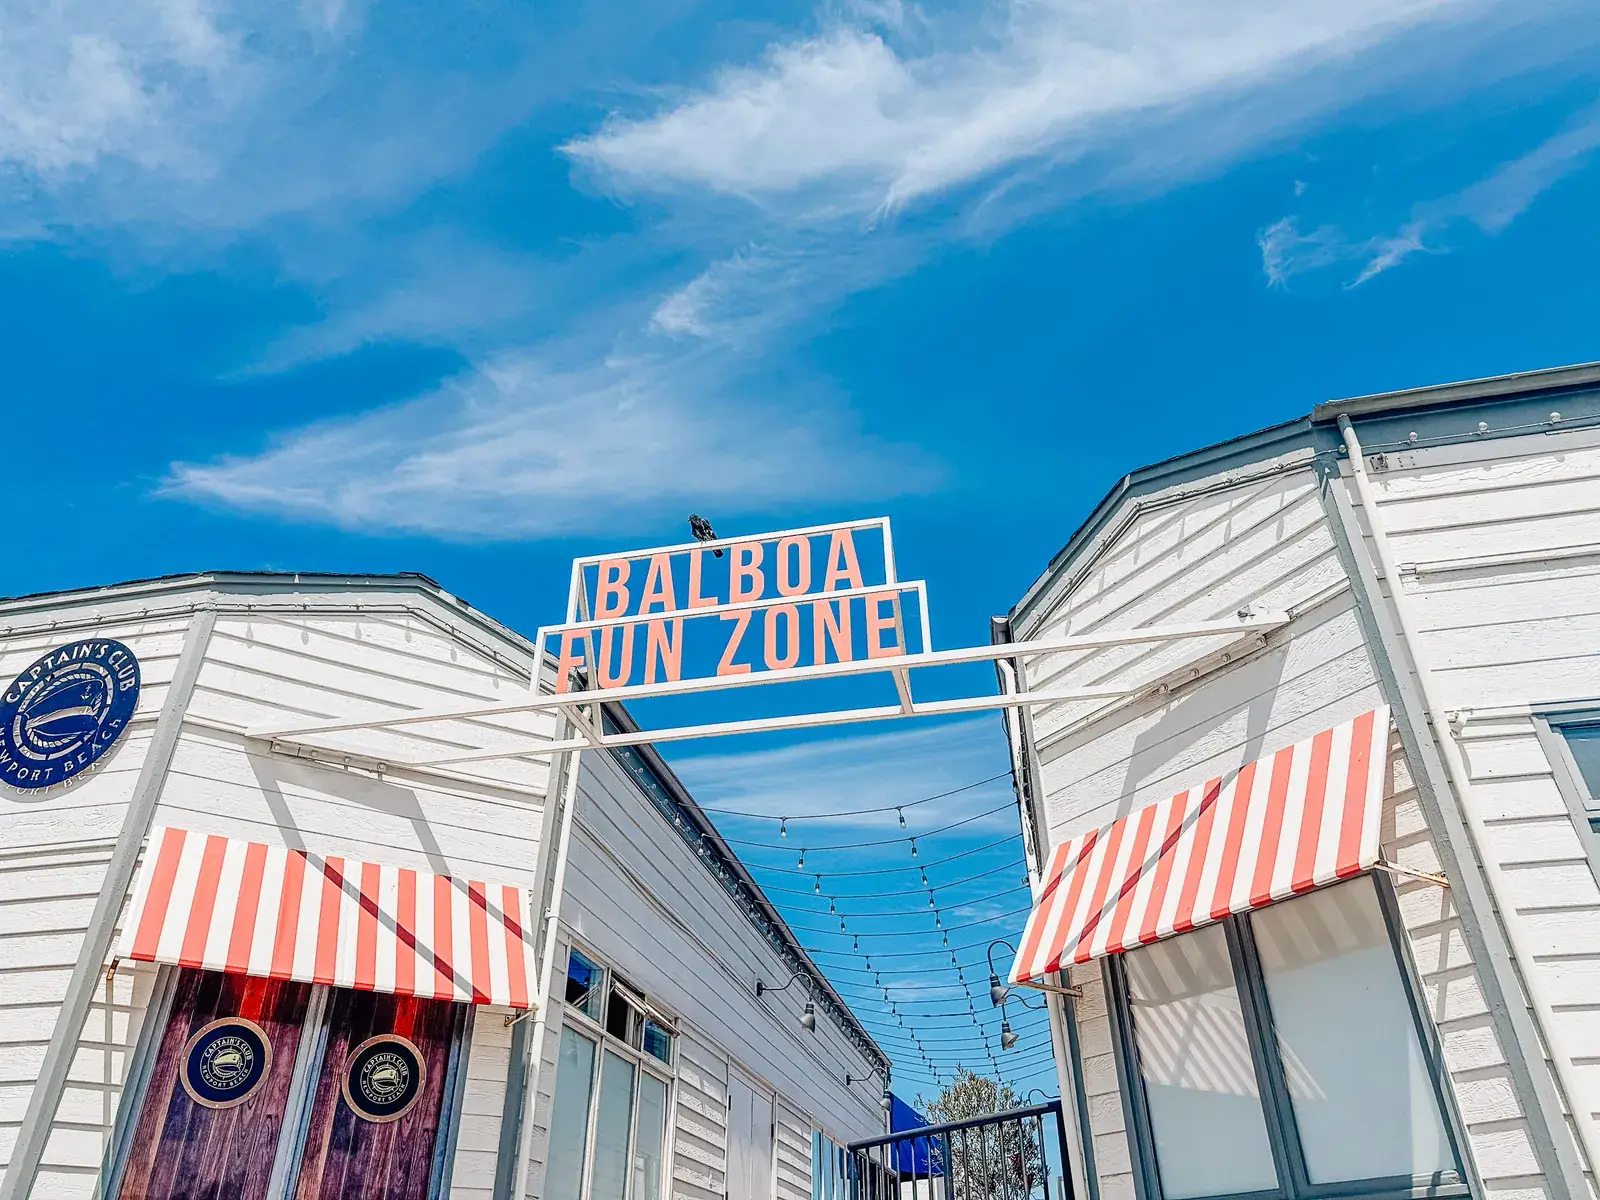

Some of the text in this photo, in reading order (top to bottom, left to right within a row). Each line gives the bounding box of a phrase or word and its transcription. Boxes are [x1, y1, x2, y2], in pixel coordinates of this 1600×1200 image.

[594, 528, 863, 621] BALBOA
[555, 590, 905, 694] FUN ZONE
[6, 644, 136, 703] CAPTAIN'S CLUB
[64, 719, 122, 772] BEACH
[204, 1038, 253, 1061] CAPTAIN'S CLUB
[364, 1054, 408, 1076] CAPTAIN'S CLUB
[202, 1065, 249, 1088] NEWPORT BEACH
[362, 1080, 406, 1102] NEWPORT BEACH
